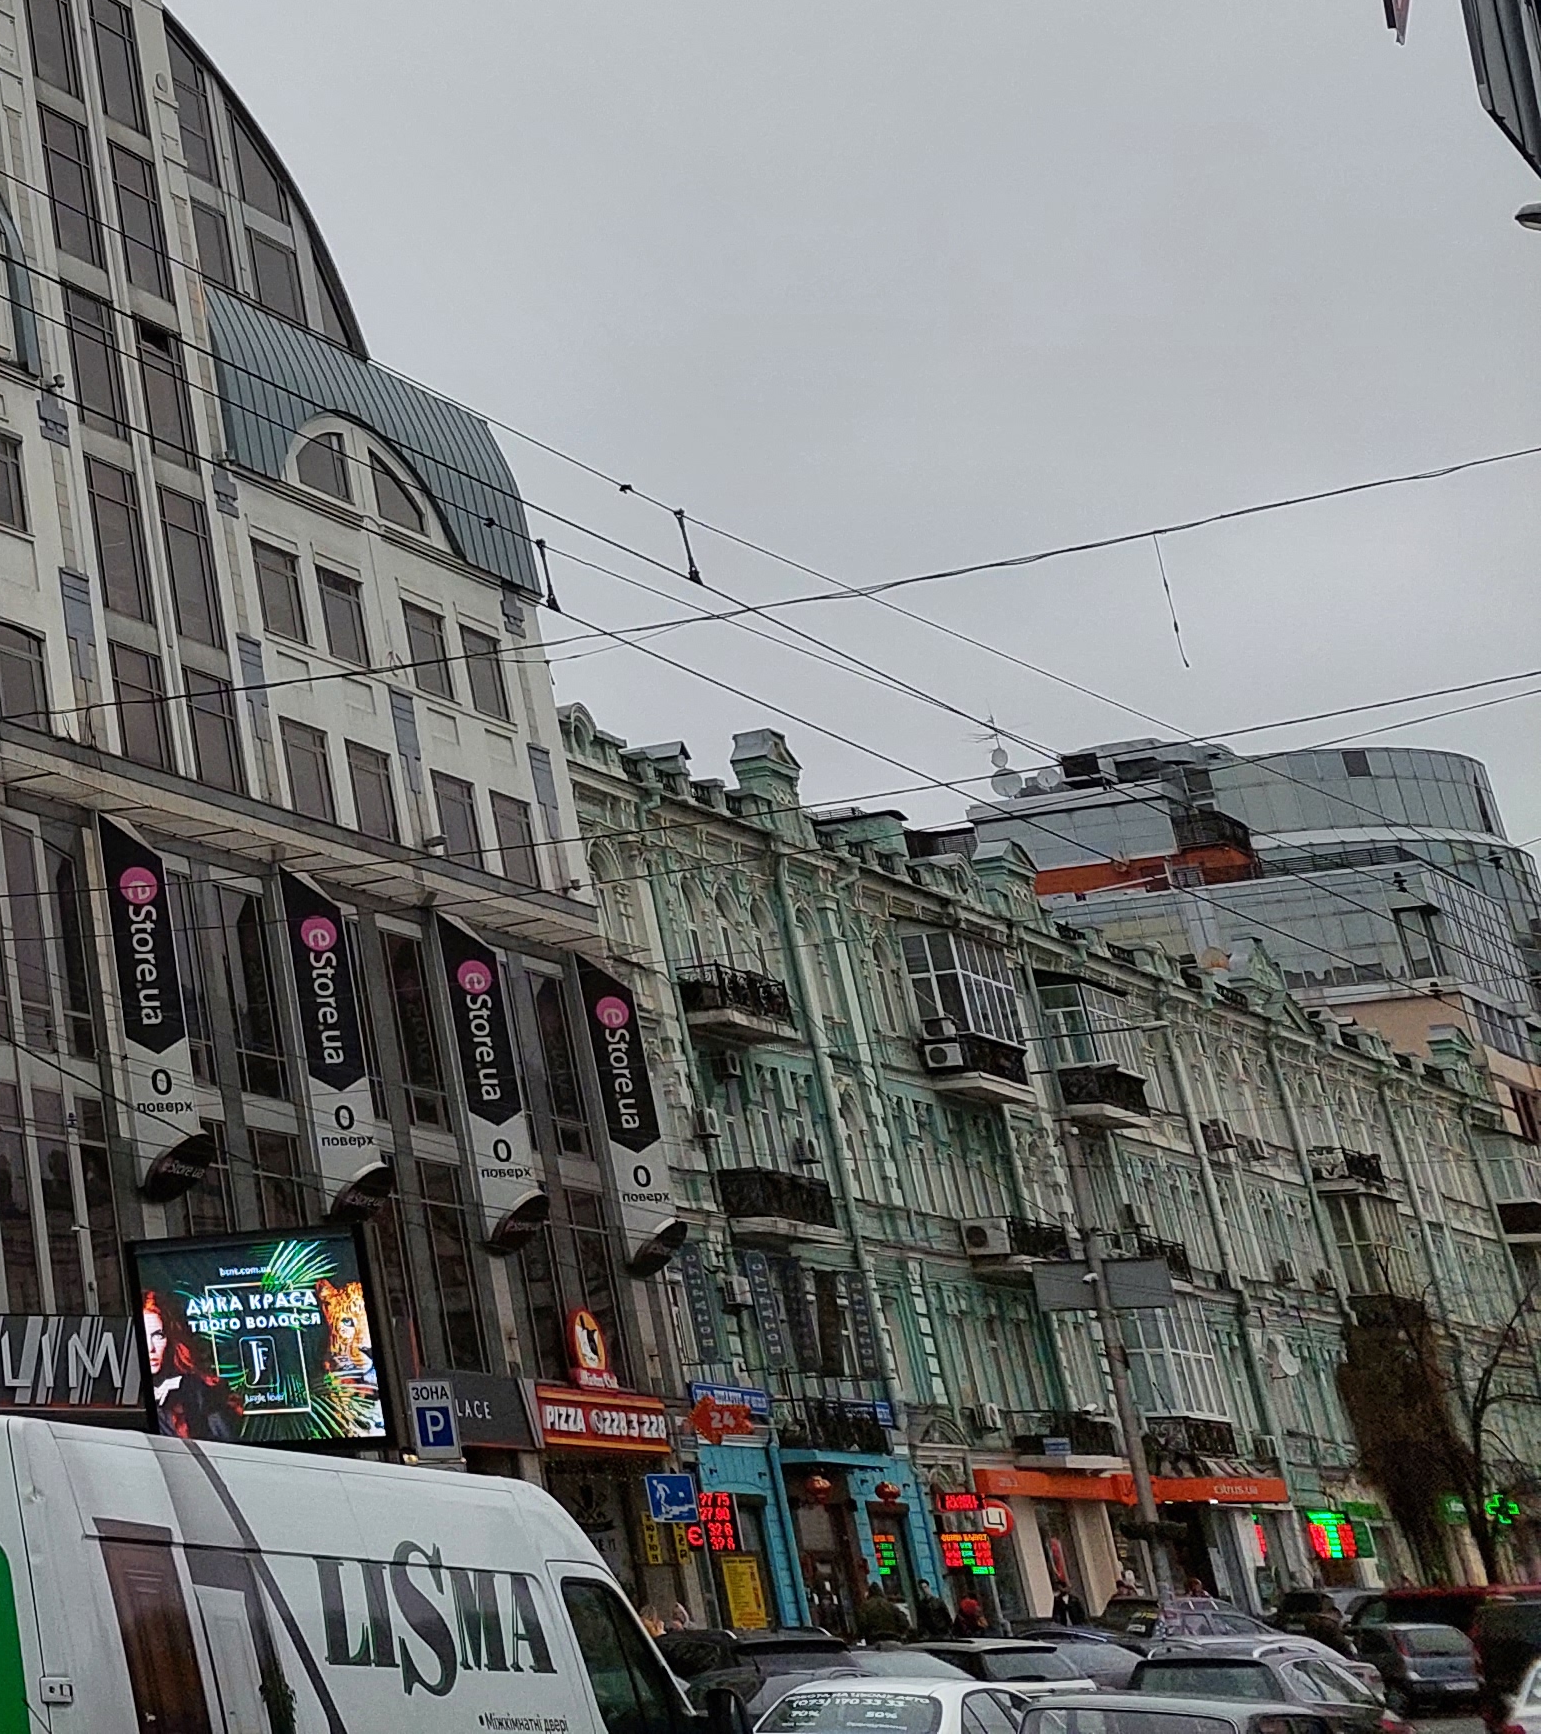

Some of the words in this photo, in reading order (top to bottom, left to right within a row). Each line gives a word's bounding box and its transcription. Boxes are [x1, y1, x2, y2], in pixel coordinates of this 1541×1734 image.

[127, 880, 164, 1025] eStore.ua
[308, 928, 344, 1064] eStore.ua
[464, 972, 501, 1101] eStore.ua
[604, 1007, 639, 1129] eStore.ua
[137, 1101, 193, 1114] поверх
[321, 1136, 374, 1147] поверх
[481, 1167, 532, 1178] поверх
[622, 1192, 671, 1203] поверх
[187, 1296, 243, 1316] ДИКА
[249, 1292, 318, 1310] КРАСА
[188, 1318, 241, 1333] ТВОГО
[246, 1312, 321, 1330] ВОЛОССЯ
[411, 1385, 449, 1401] ЗОНА
[455, 1399, 492, 1420] LACE
[543, 1405, 586, 1433] PIZZA
[710, 1412, 735, 1428] 24
[313, 1540, 558, 1697] LISMA
[485, 1712, 543, 1732] Міжкімнатні
[544, 1715, 569, 1734] двері
